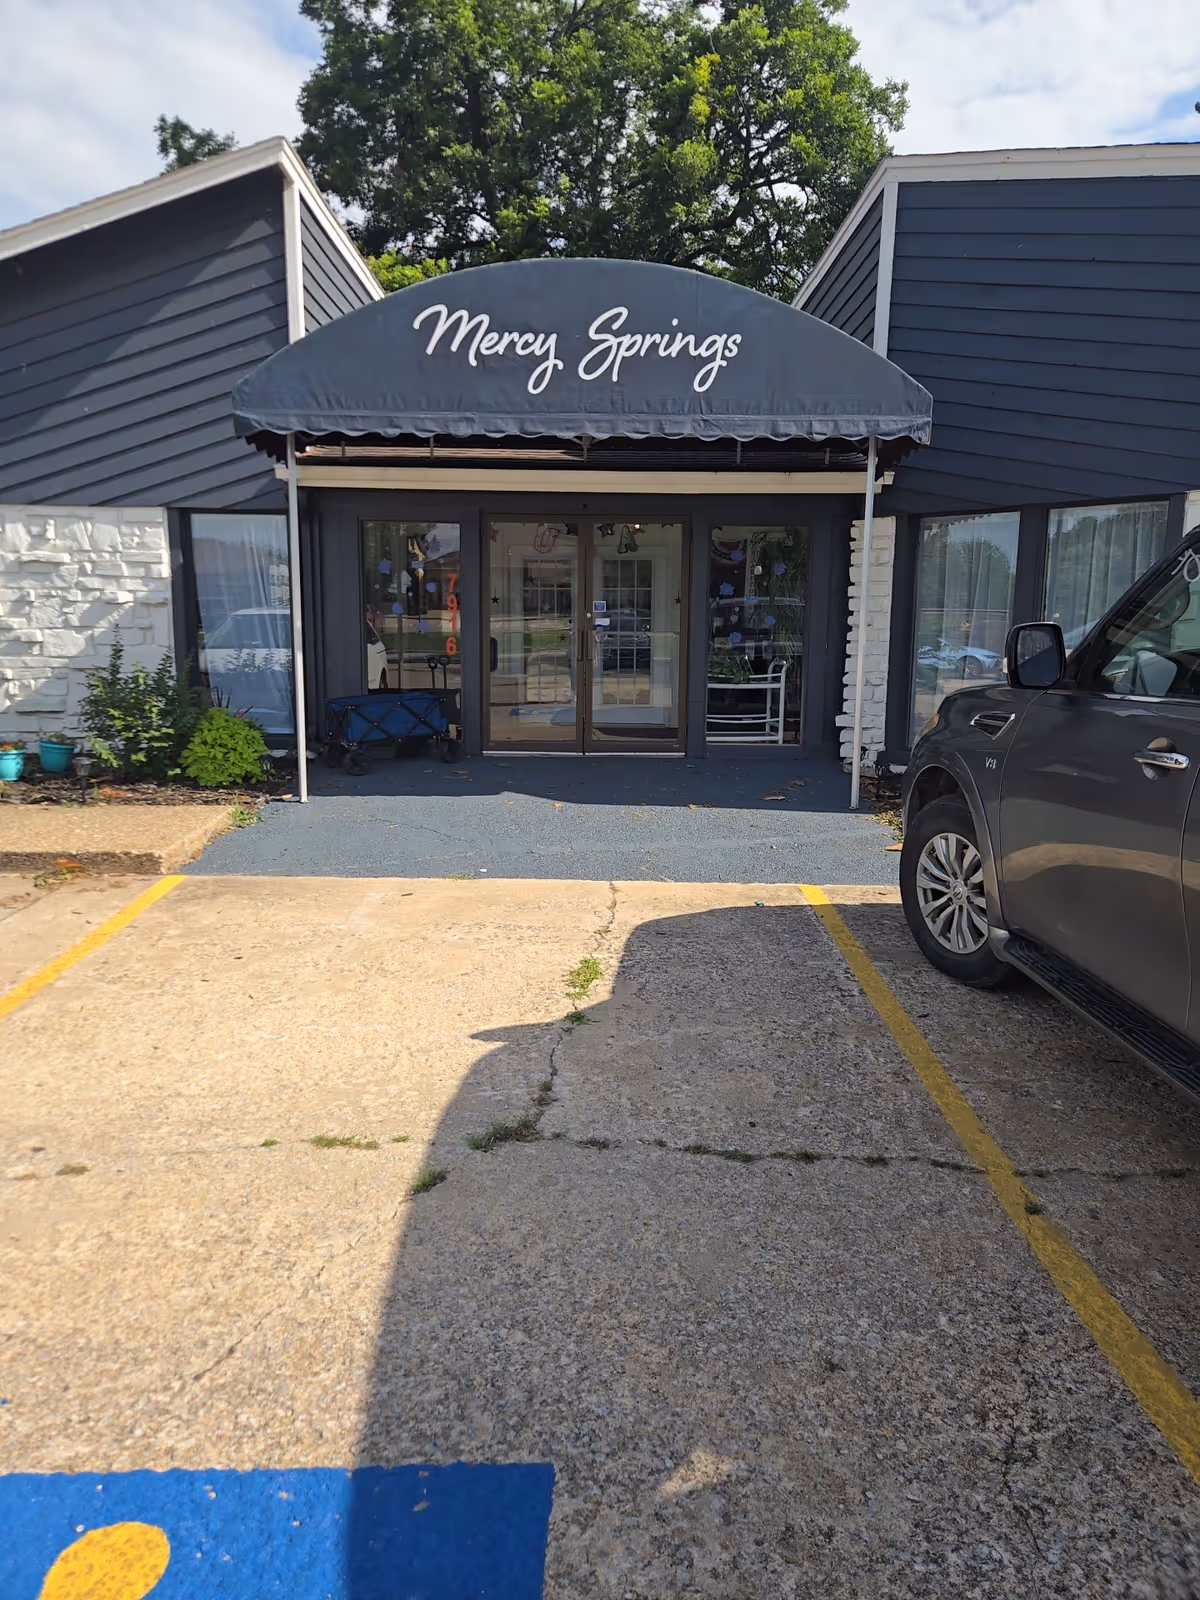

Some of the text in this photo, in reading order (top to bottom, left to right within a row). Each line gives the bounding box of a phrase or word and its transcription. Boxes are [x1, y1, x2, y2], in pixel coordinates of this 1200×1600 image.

[412, 303, 743, 395] Mercy Springs
[445, 572, 458, 656] 7916
[985, 756, 997, 770] V8
